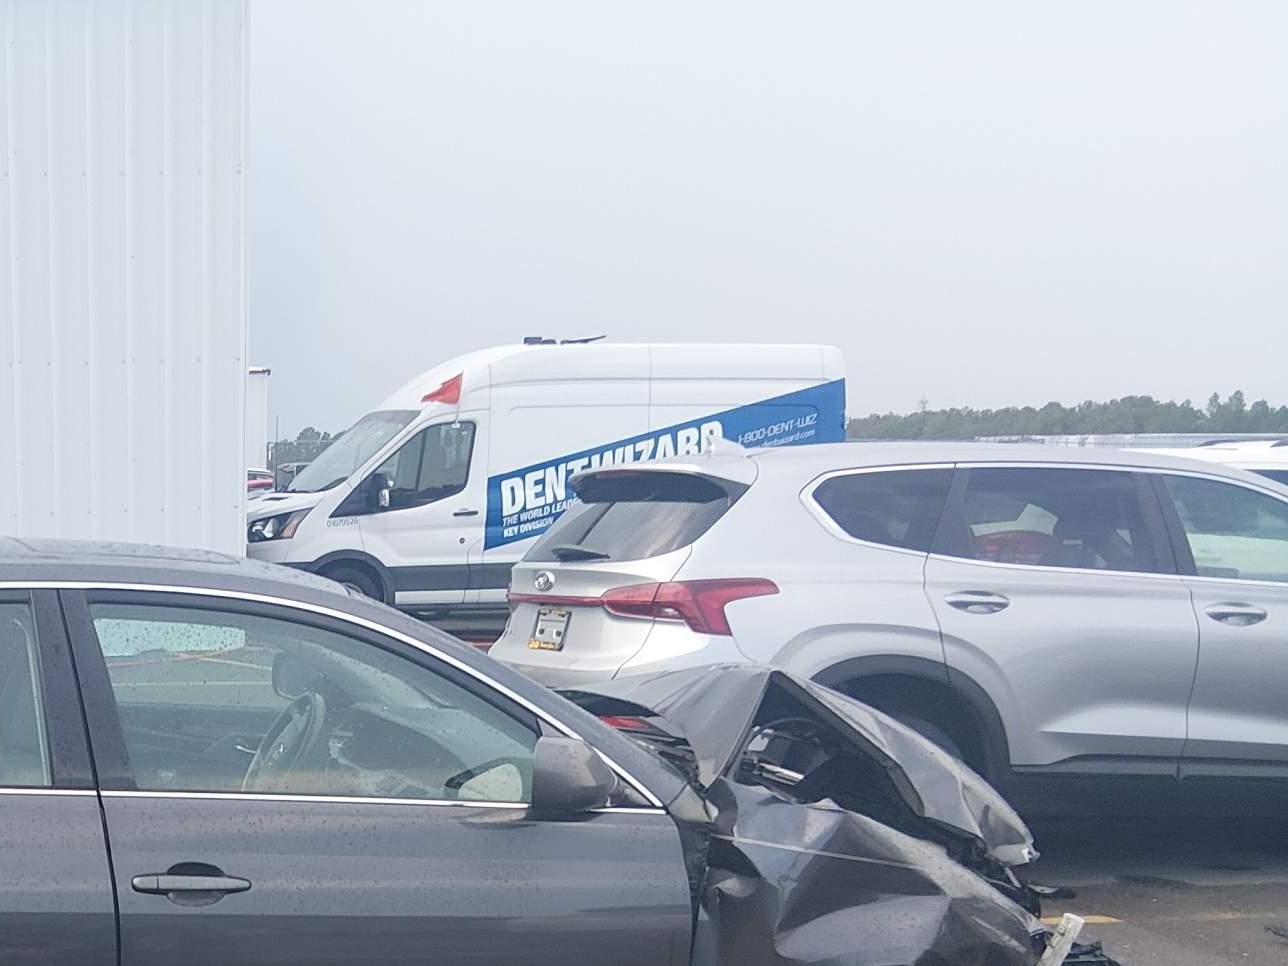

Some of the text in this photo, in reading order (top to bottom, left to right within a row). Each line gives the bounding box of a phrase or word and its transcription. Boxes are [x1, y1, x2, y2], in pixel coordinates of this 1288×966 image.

[502, 514, 519, 527] THE
[520, 505, 551, 521] WORLD
[503, 516, 554, 538] KEY DIVISION
